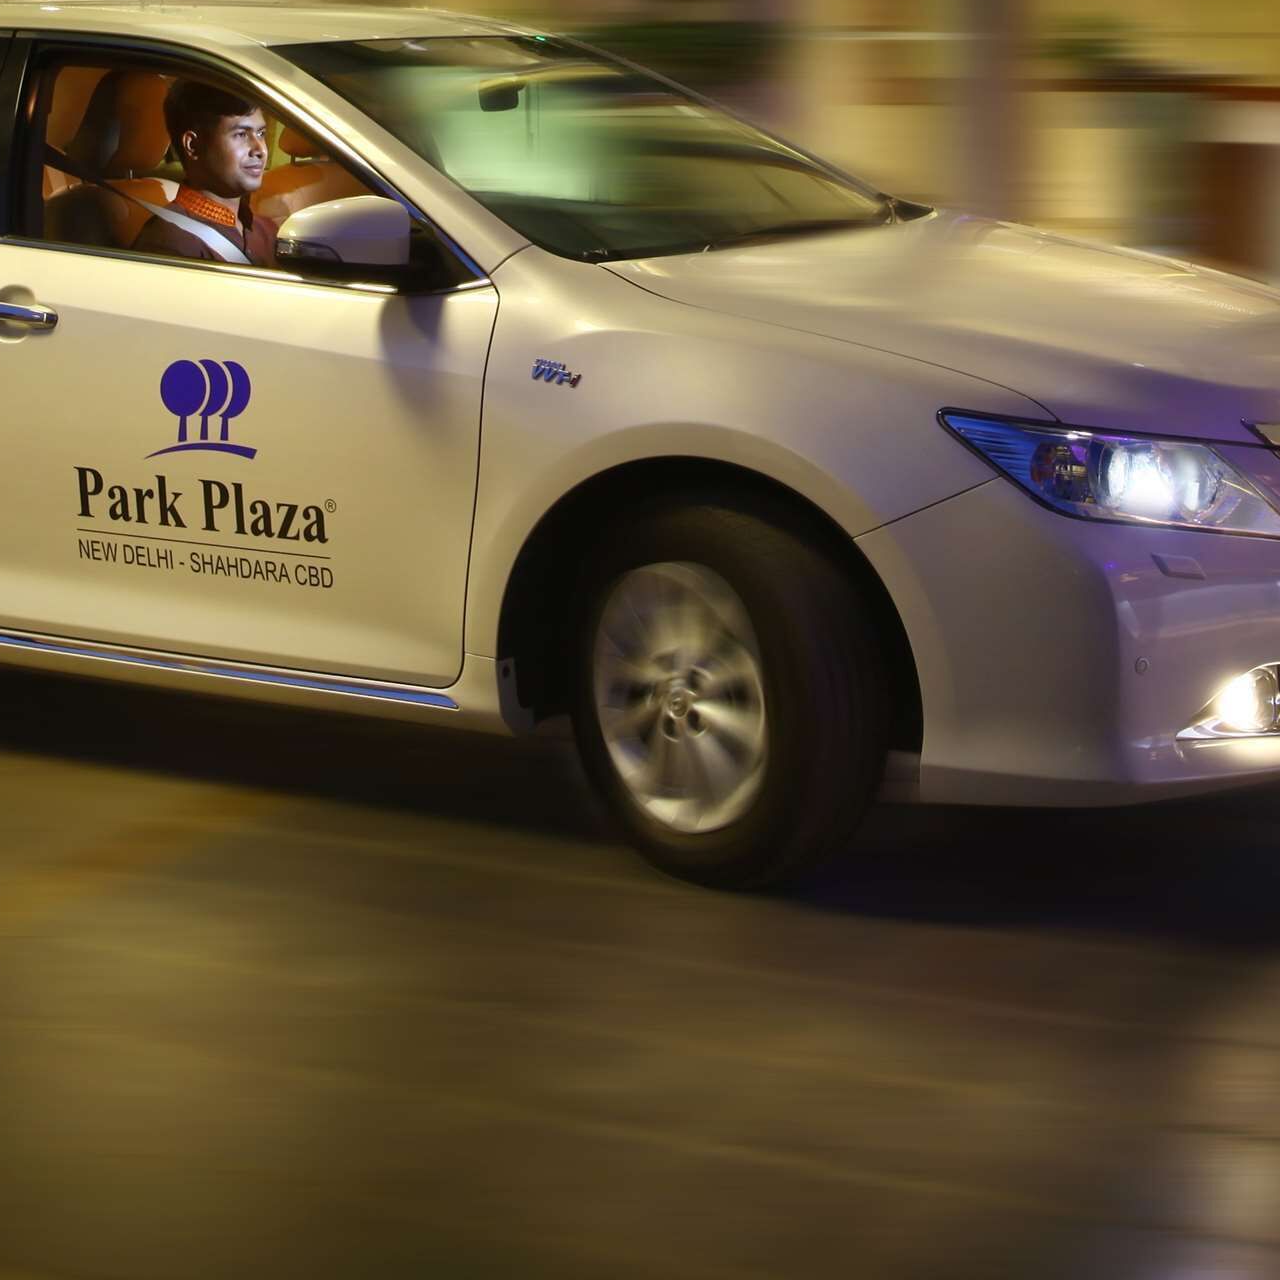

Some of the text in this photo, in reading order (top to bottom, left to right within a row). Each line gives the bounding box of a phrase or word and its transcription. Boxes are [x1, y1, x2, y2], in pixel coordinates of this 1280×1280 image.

[73, 466, 188, 529] Park
[78, 538, 118, 563] NEW
[123, 543, 175, 570] DELHI
[190, 552, 292, 584] SHAHDARA
[294, 564, 334, 589] CBD
